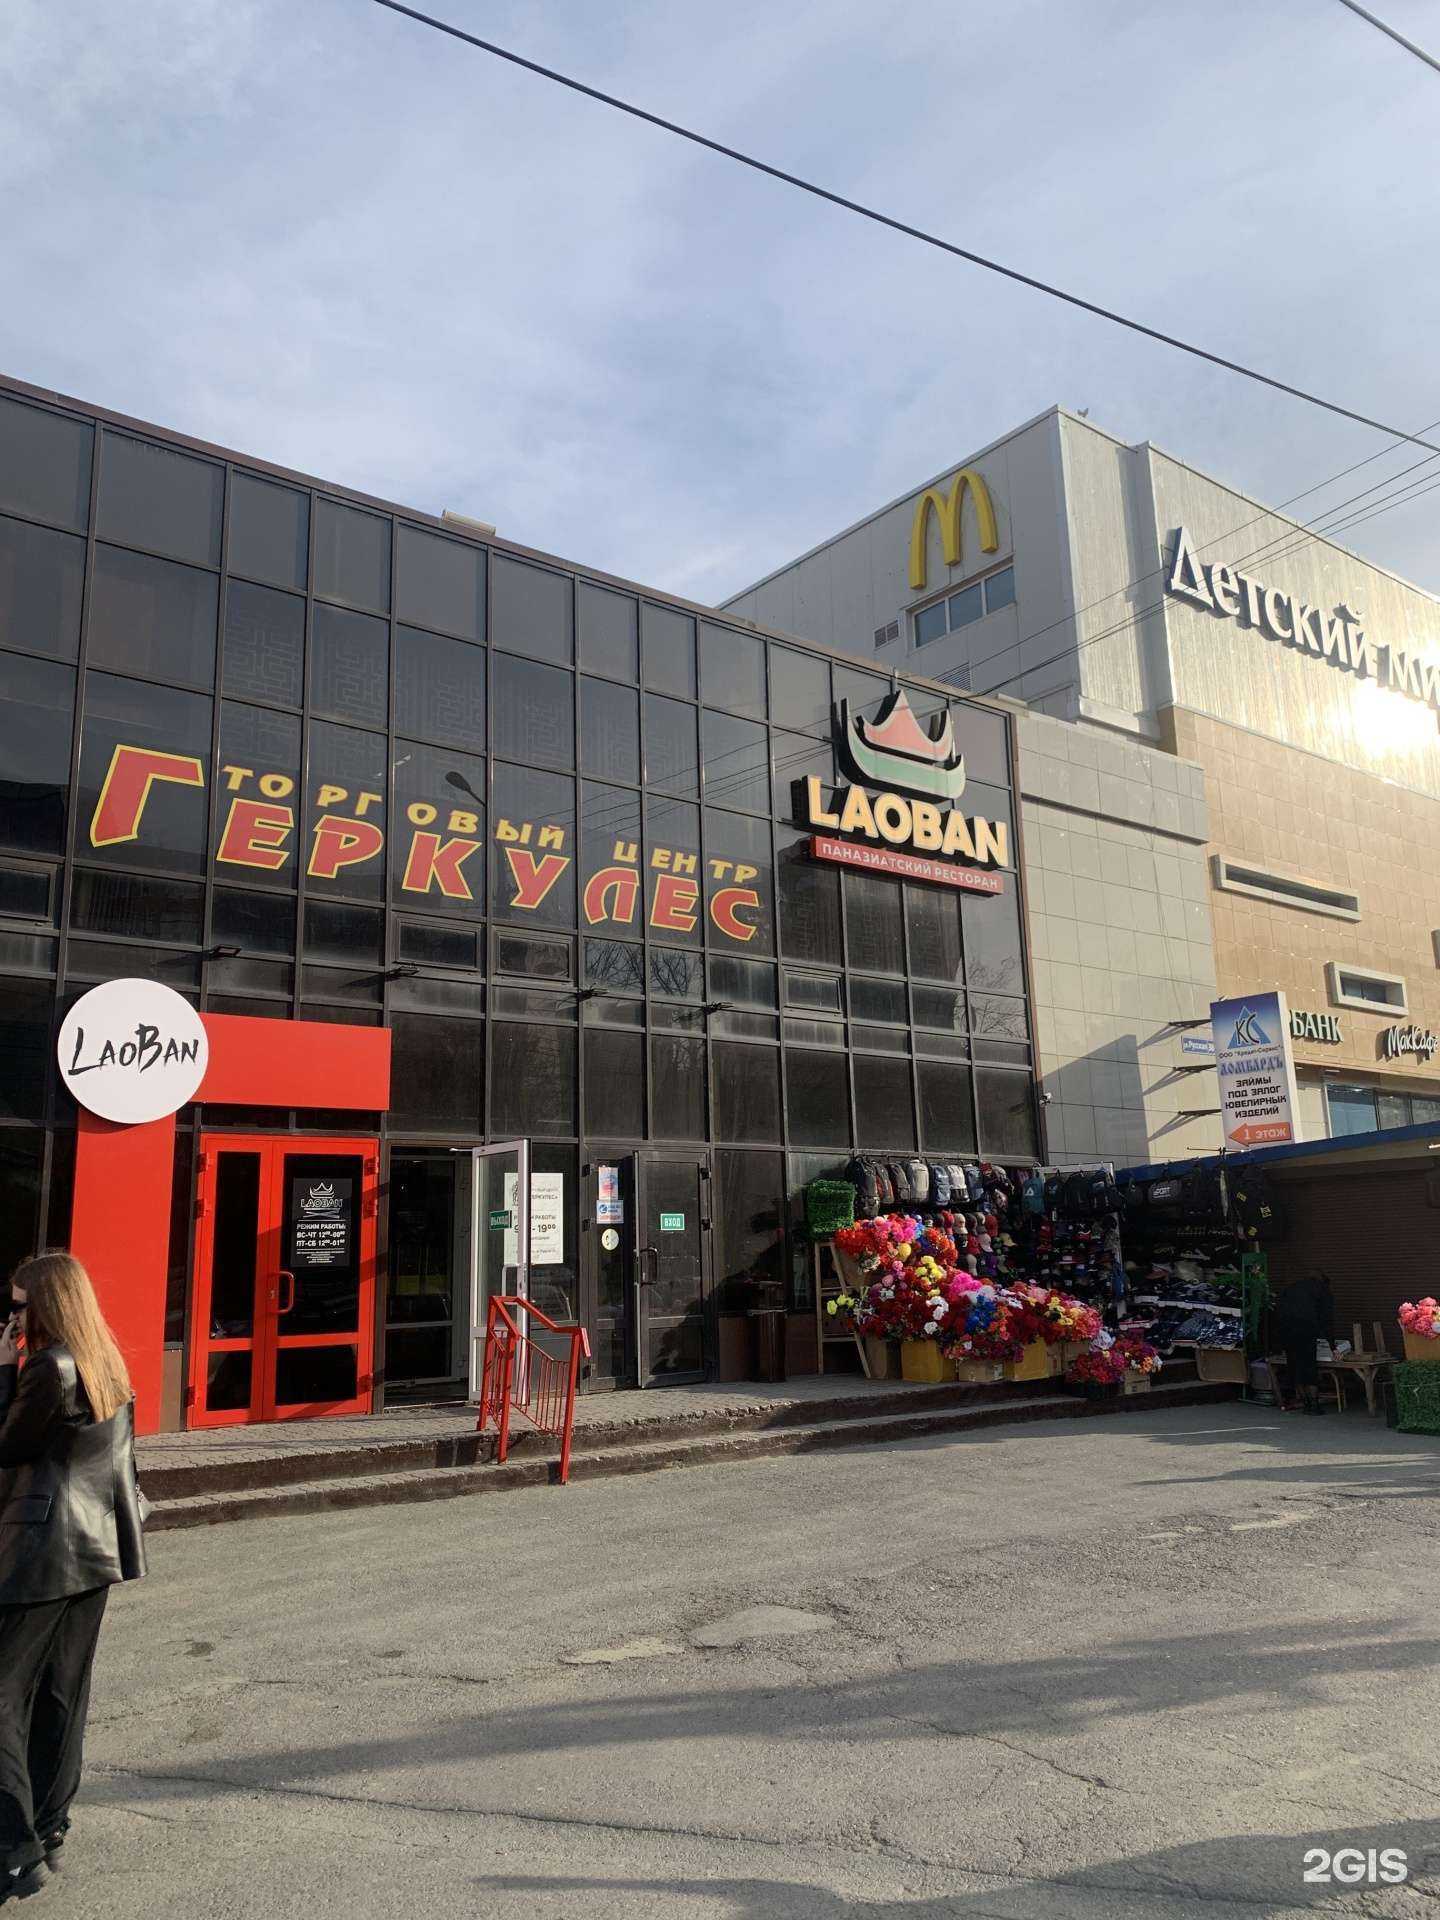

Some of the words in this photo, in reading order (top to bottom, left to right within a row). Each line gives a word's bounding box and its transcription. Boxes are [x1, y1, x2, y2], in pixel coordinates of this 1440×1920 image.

[222, 765, 565, 850] ТОРГОВЫЙ
[613, 841, 758, 883] ЦЕНТР
[806, 774, 1009, 867] LAOBAN
[90, 744, 758, 941] ГЕРКУЛЕС
[822, 843, 932, 875] ПАНАЗИАТСКИЙ
[935, 867, 998, 889] РЕСТОРАН
[1235, 1076, 1272, 1087] ЗАЙМЫ
[1227, 1089, 1248, 1099] ПОД
[1251, 1085, 1281, 1096] ЗАЛОГ
[1234, 1106, 1279, 1119] ИЗДЕЛИЙ
[1243, 1129, 1251, 1140] 1
[664, 1217, 681, 1227] ВХОД
